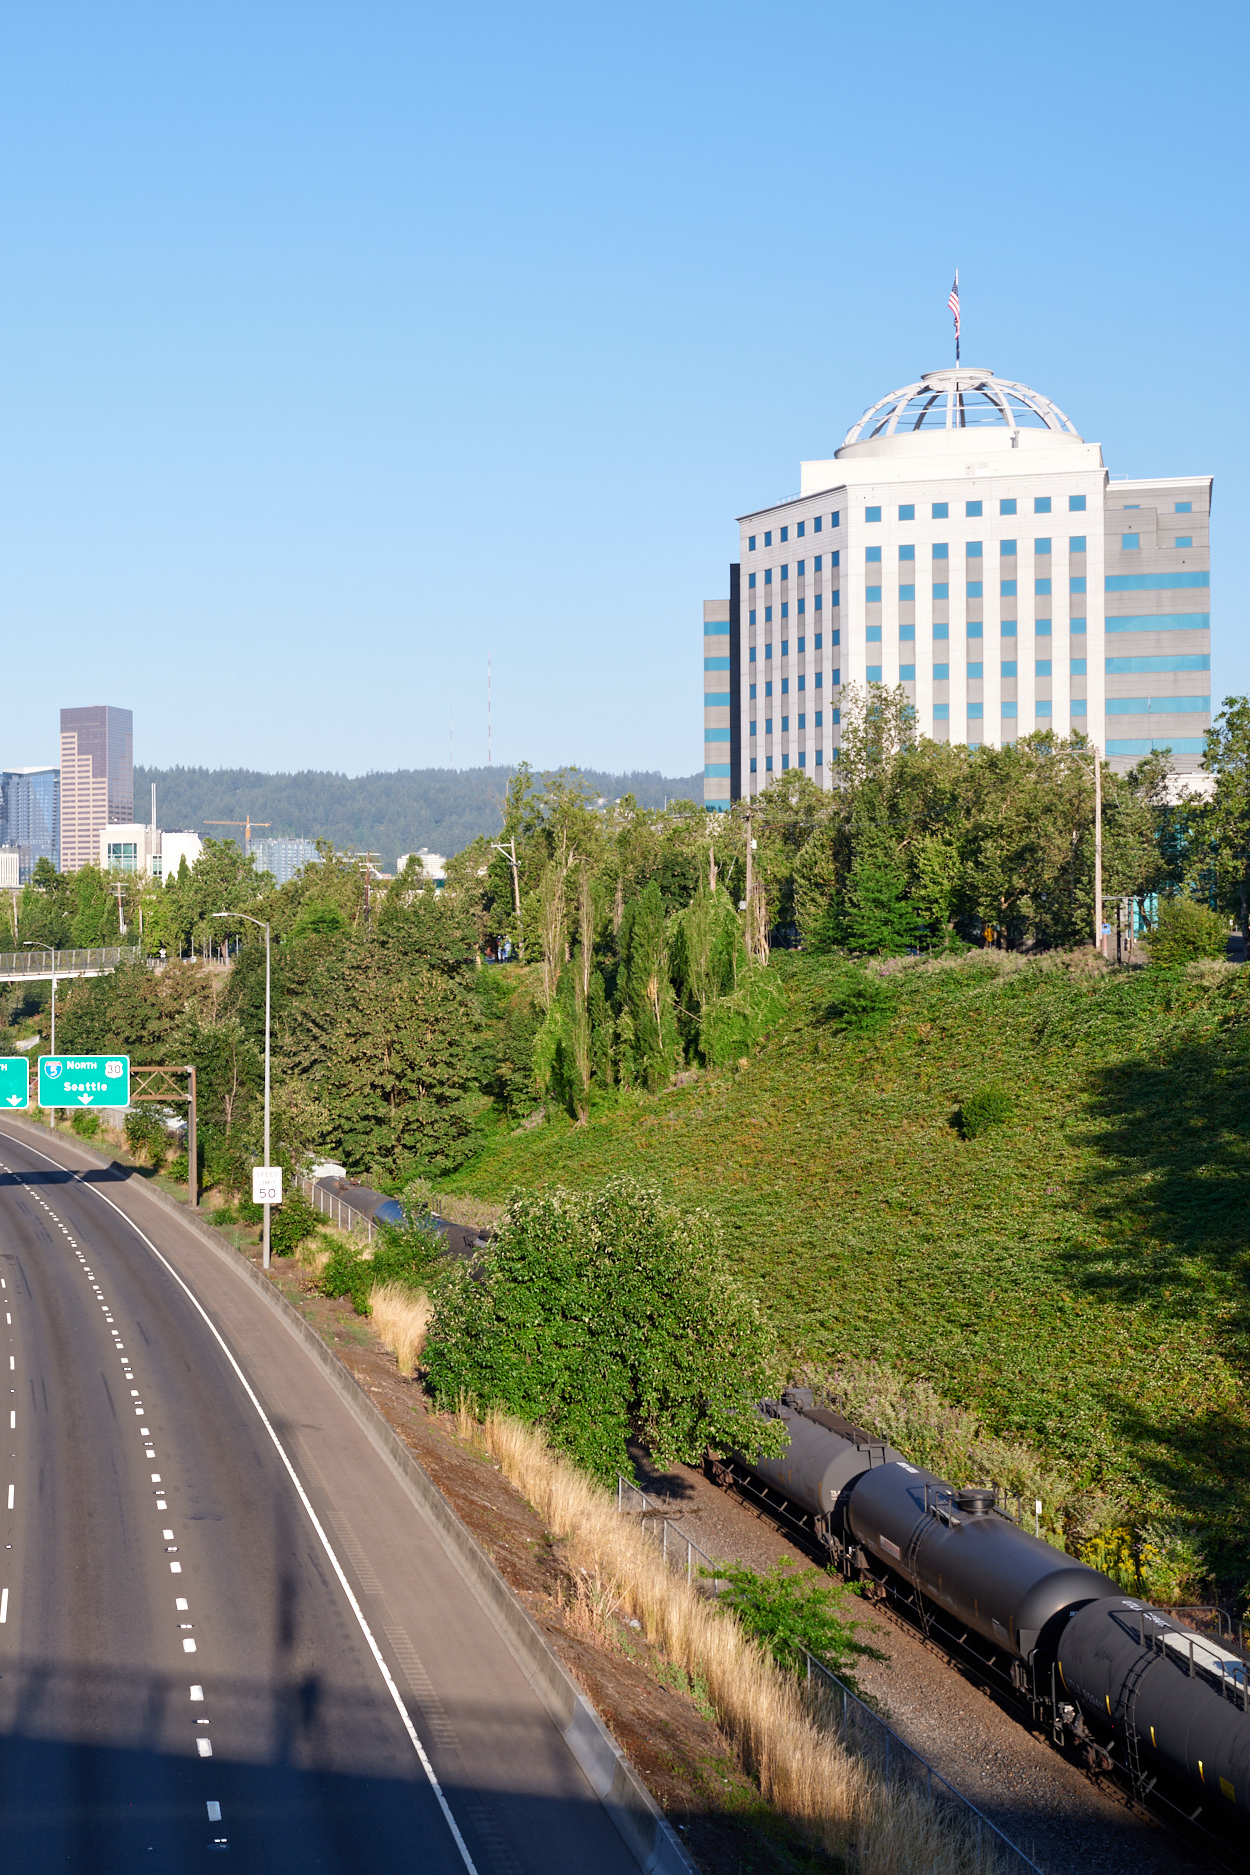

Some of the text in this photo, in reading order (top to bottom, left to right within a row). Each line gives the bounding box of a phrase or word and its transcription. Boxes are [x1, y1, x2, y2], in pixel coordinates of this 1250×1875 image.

[50, 1061, 121, 1076] 5 NORTH 30
[63, 1082, 107, 1091] Seattle
[259, 1188, 276, 1198] 50
